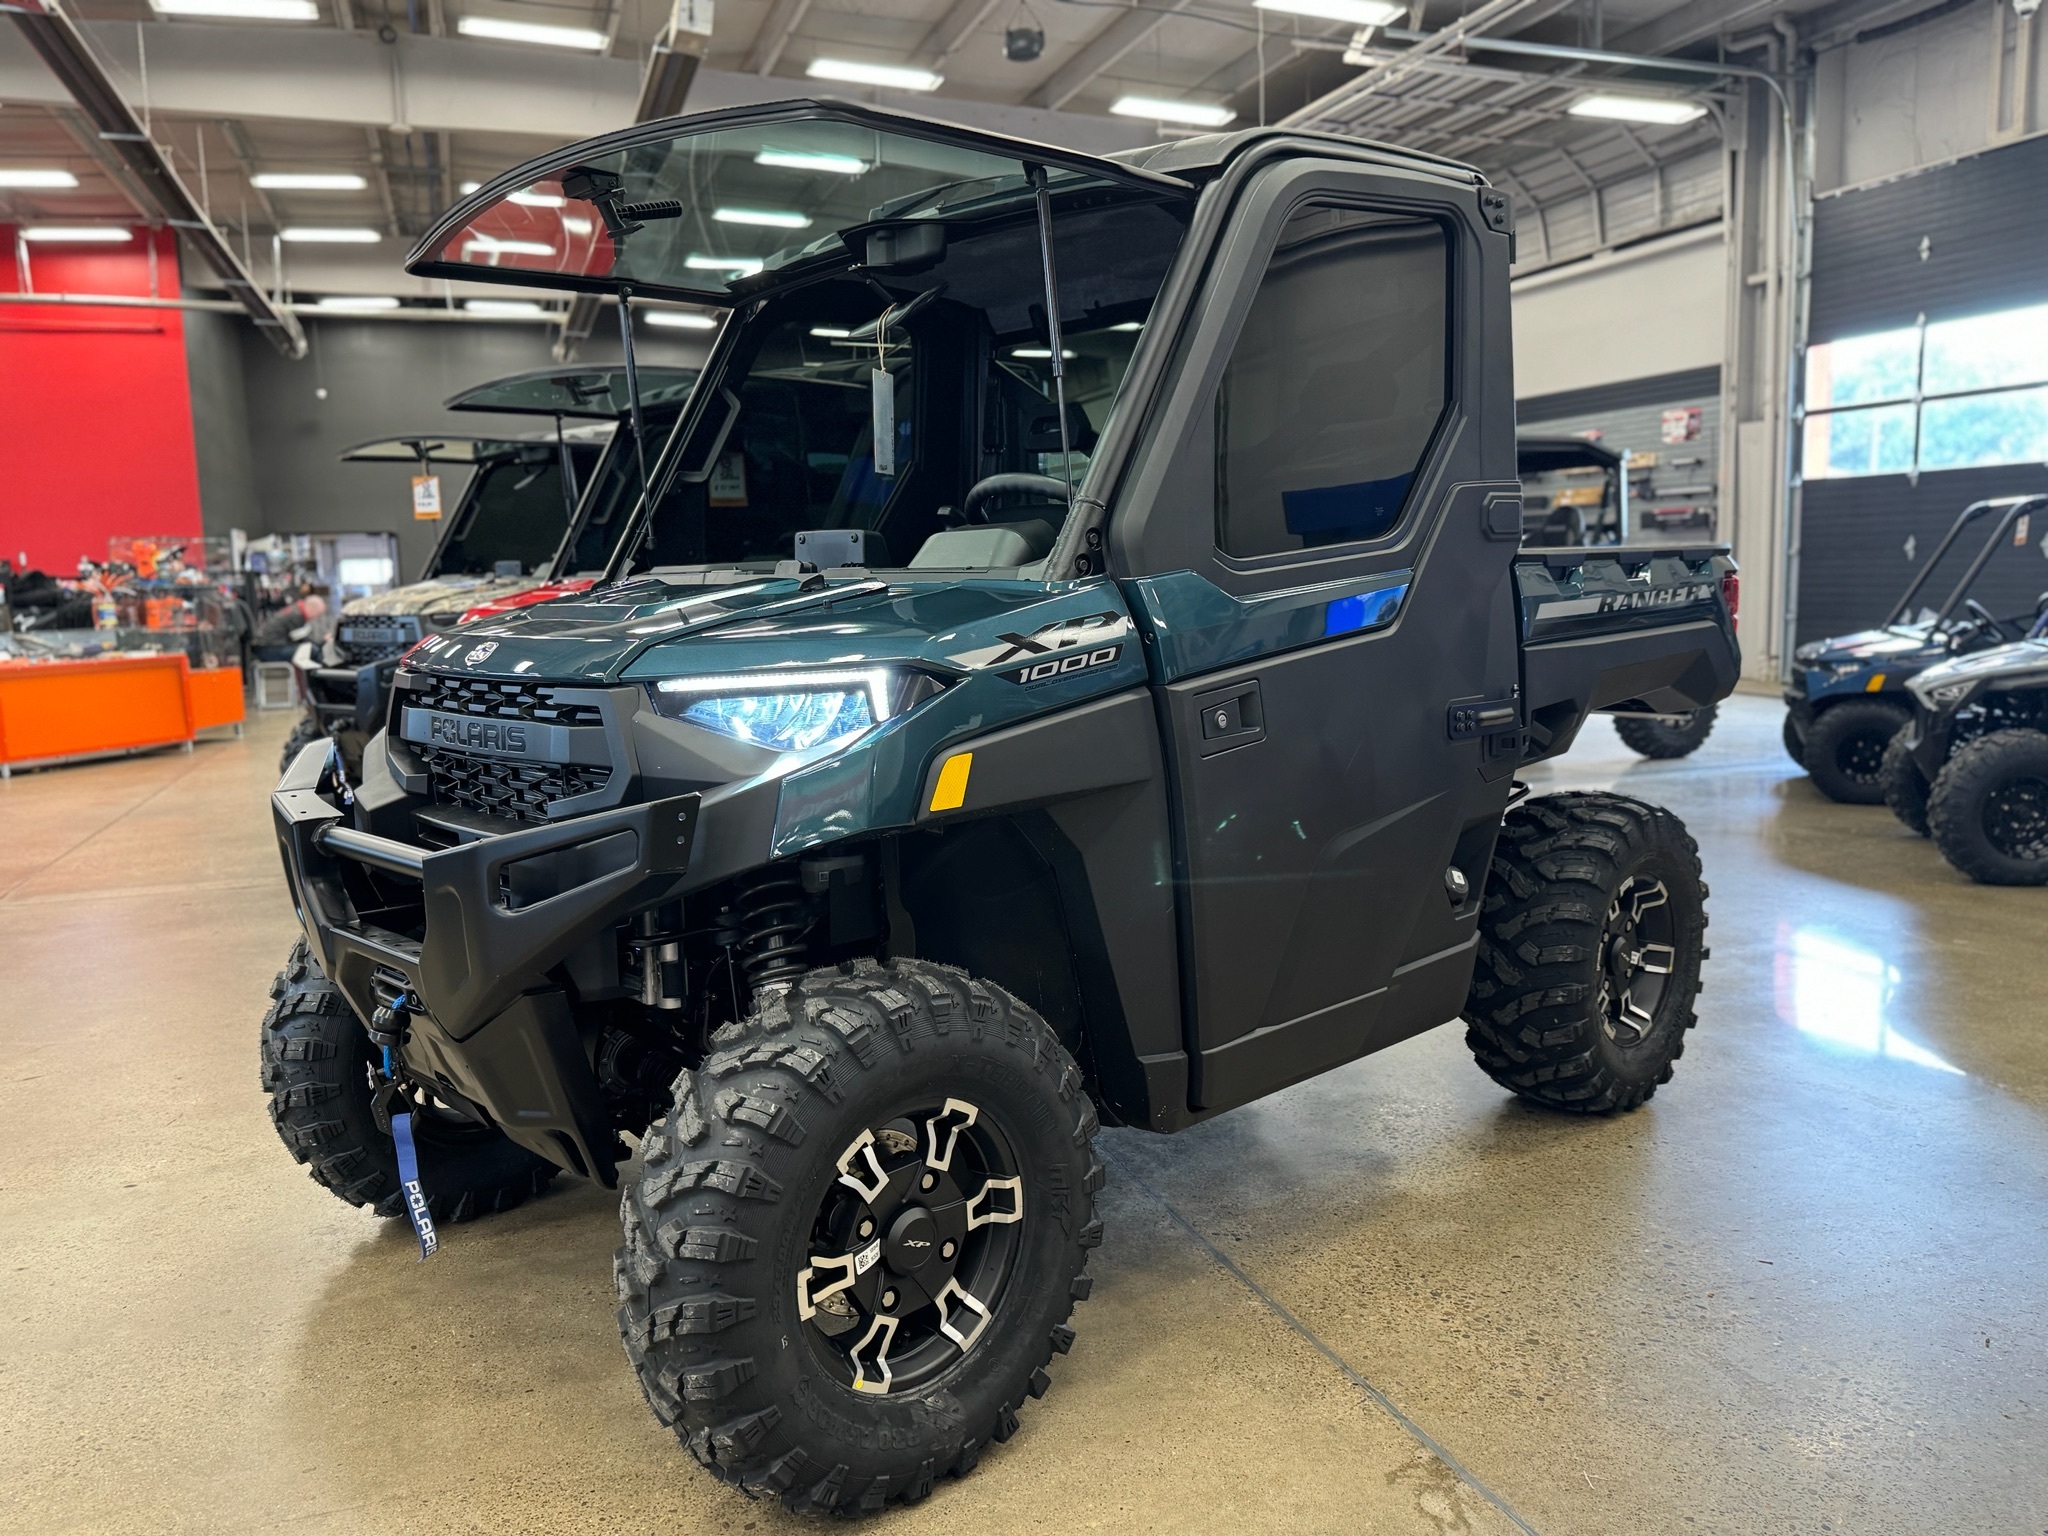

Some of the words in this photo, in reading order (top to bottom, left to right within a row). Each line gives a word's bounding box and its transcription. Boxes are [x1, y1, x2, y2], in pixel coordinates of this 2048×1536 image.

[1598, 586, 1704, 614] RANGER
[984, 610, 1122, 667] XP
[1019, 646, 1117, 684] 1000
[1024, 680, 1050, 692] DUAL
[1050, 668, 1099, 684] OVERHEAD
[1099, 663, 1119, 673] CAM
[430, 715, 527, 754] POLARIS
[404, 1180, 438, 1257] POLARIS
[902, 1239, 931, 1248] XP
